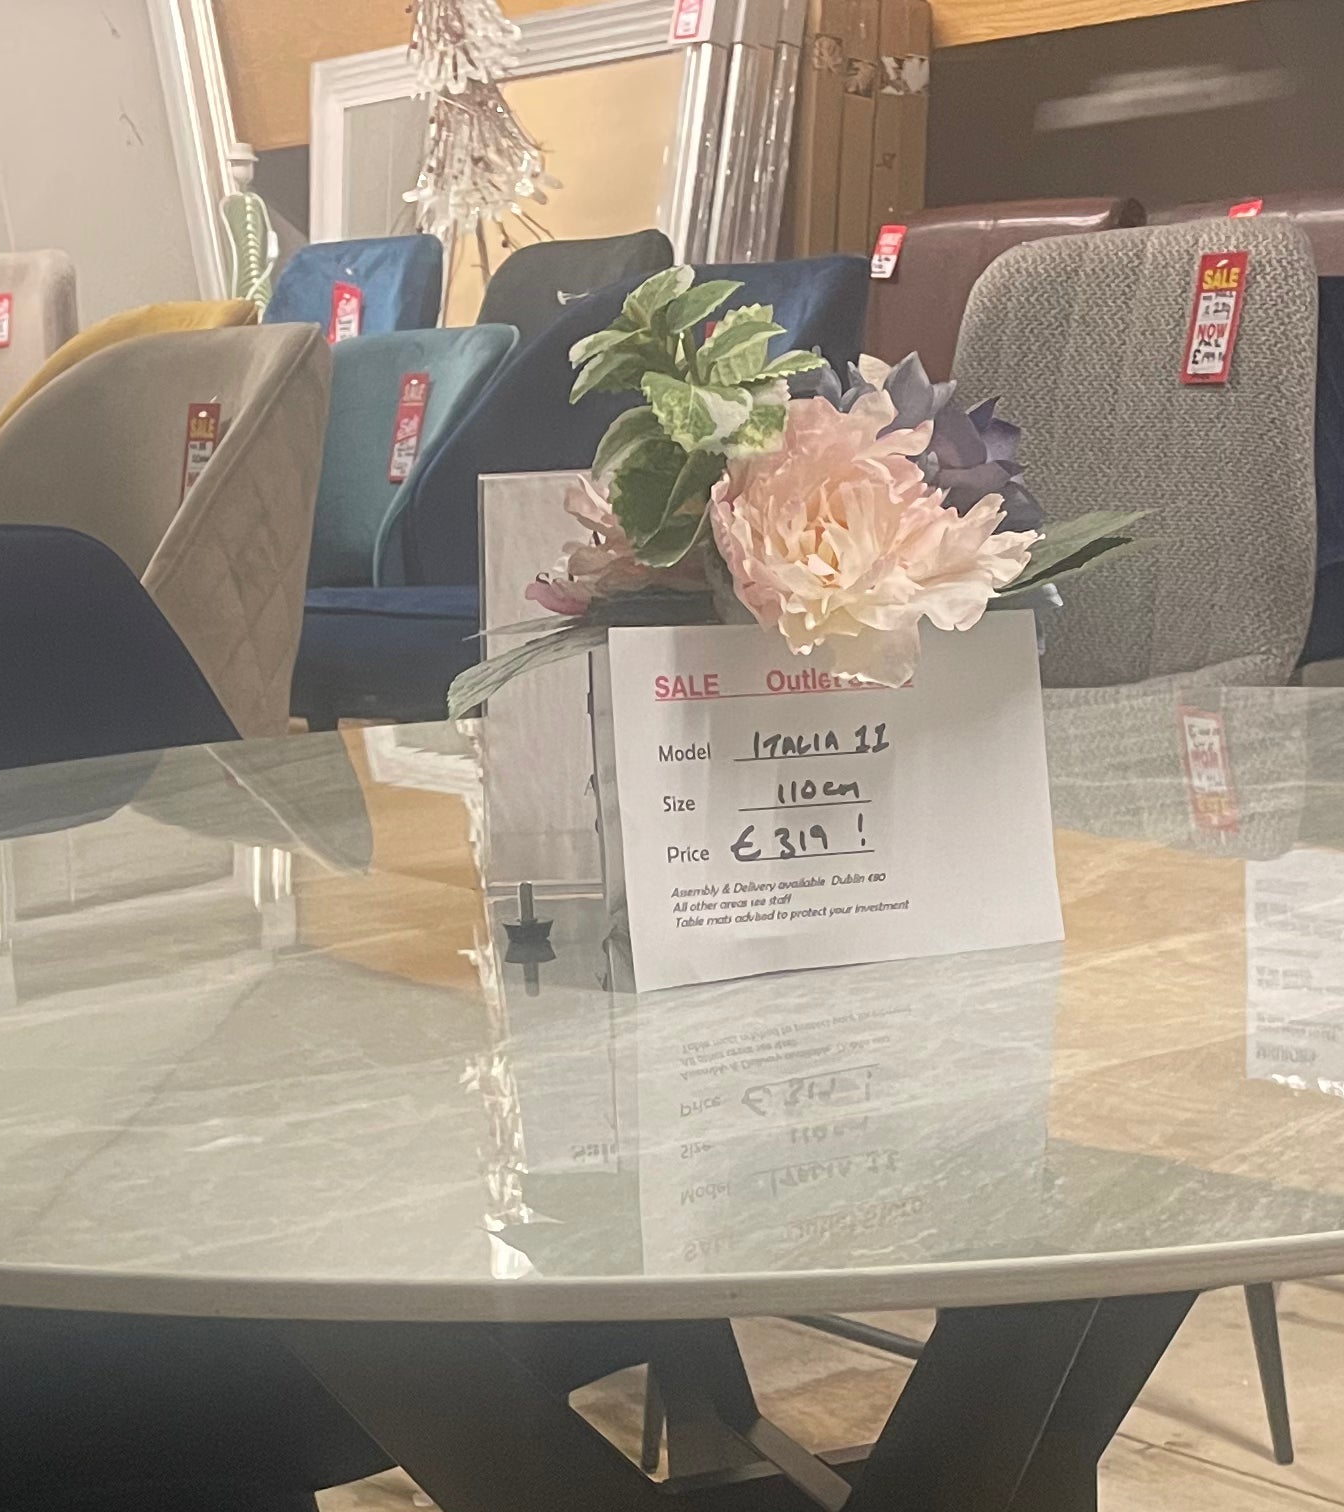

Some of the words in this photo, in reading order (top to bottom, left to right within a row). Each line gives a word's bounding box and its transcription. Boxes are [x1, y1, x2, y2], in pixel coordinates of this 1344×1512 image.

[1202, 267, 1241, 290] SALE
[1197, 323, 1228, 340] NOW
[189, 418, 215, 438] SALE
[655, 673, 719, 699] SALE
[766, 669, 842, 692] Outlet
[659, 742, 712, 763] Model
[754, 731, 839, 759] ITALIA
[663, 796, 696, 813] Size
[667, 846, 710, 863] Price
[671, 884, 719, 898] Assembly
[722, 883, 731, 894] &
[733, 881, 776, 894] Delivery
[778, 876, 825, 890] available
[831, 873, 865, 886] Dublin
[673, 902, 687, 913] All
[690, 900, 717, 912] other
[720, 899, 748, 910] areas
[751, 898, 766, 907] see
[769, 893, 792, 906] staff
[676, 916, 704, 928] Table
[706, 914, 732, 926] mats
[735, 909, 775, 923] advised
[777, 910, 788, 920] to
[790, 906, 827, 920] protect
[829, 905, 853, 917] your
[855, 899, 910, 913] investment
